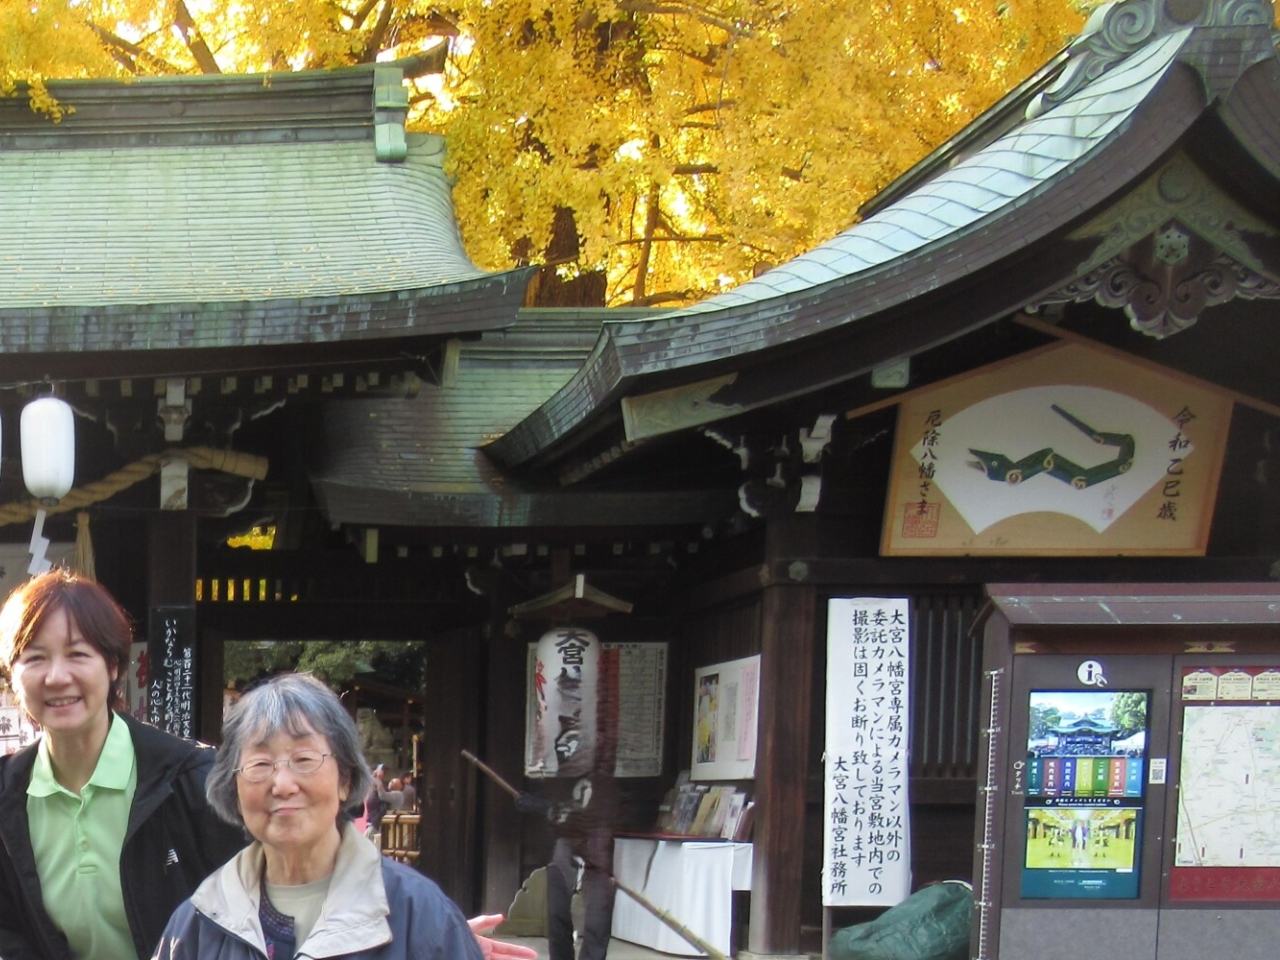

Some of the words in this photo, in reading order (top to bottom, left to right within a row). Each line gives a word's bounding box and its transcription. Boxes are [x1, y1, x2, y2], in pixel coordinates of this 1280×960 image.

[918, 409, 943, 515] 厄除八幡さま
[1156, 406, 1197, 521] 令和乙巳歳
[830, 756, 850, 896] 大宮八幡宮社務所
[851, 609, 870, 868] 撮影は固くお断り致しております
[867, 609, 888, 895] 委託カメラマンによる当宮敷地内での
[886, 608, 906, 862] 大宮八幡宮専属カメラマン以外の
